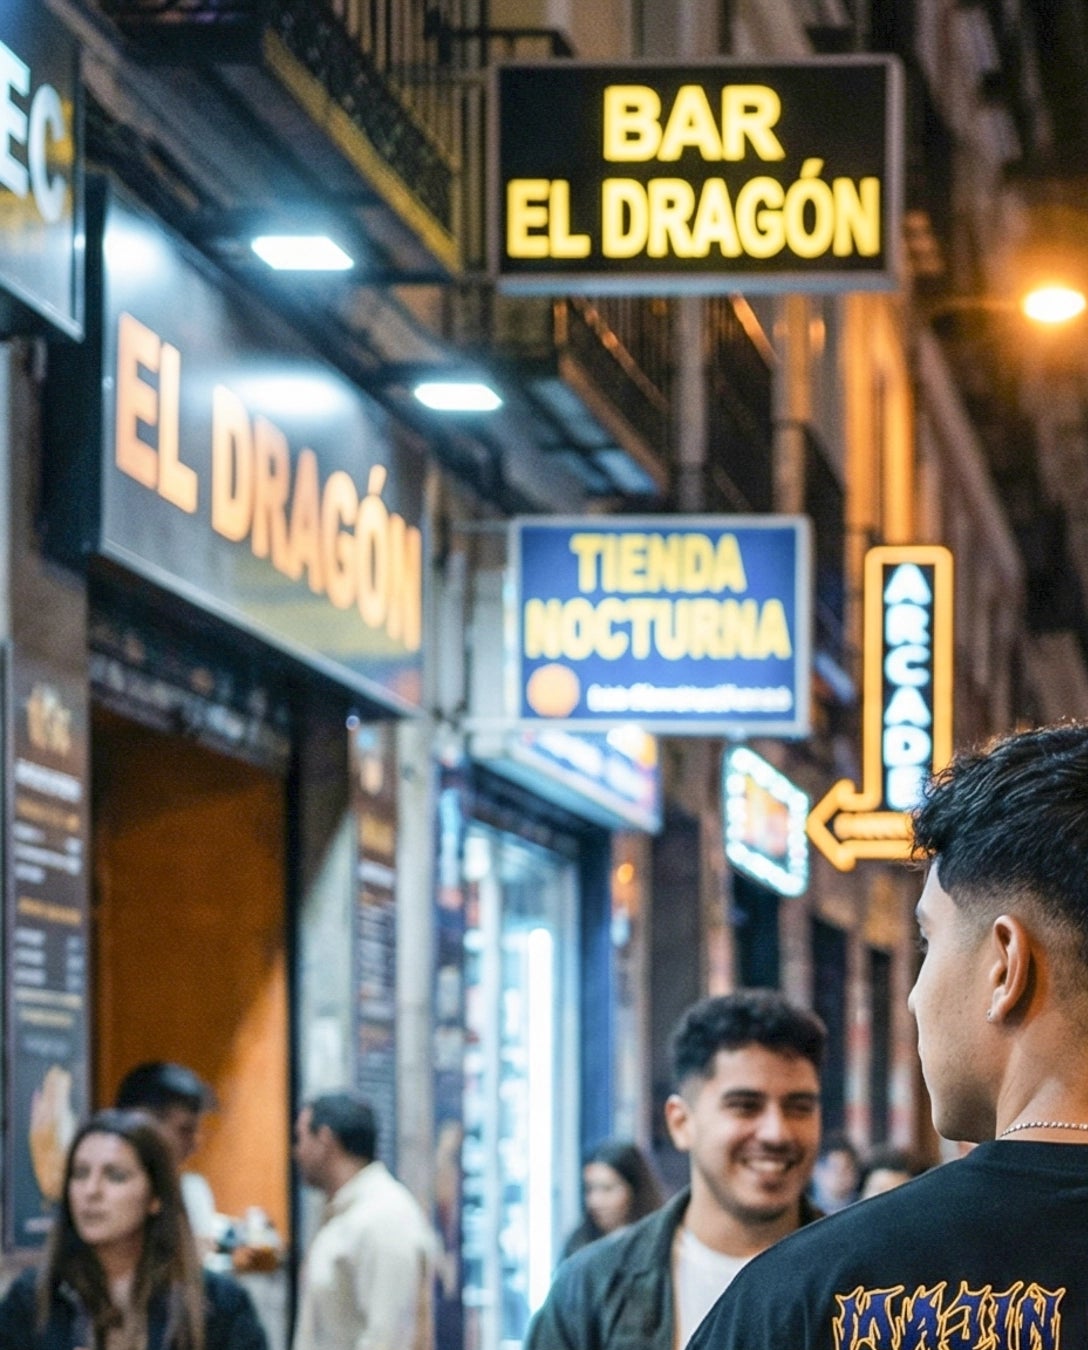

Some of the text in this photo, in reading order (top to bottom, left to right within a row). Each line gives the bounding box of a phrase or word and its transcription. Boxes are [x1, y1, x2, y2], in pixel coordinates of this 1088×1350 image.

[603, 84, 786, 162] BAR
[507, 157, 880, 259] EL DRAGÓN
[115, 311, 423, 653] EL DRAGÓN
[569, 532, 748, 594] TIENDA
[524, 597, 792, 660] NOCTURNA
